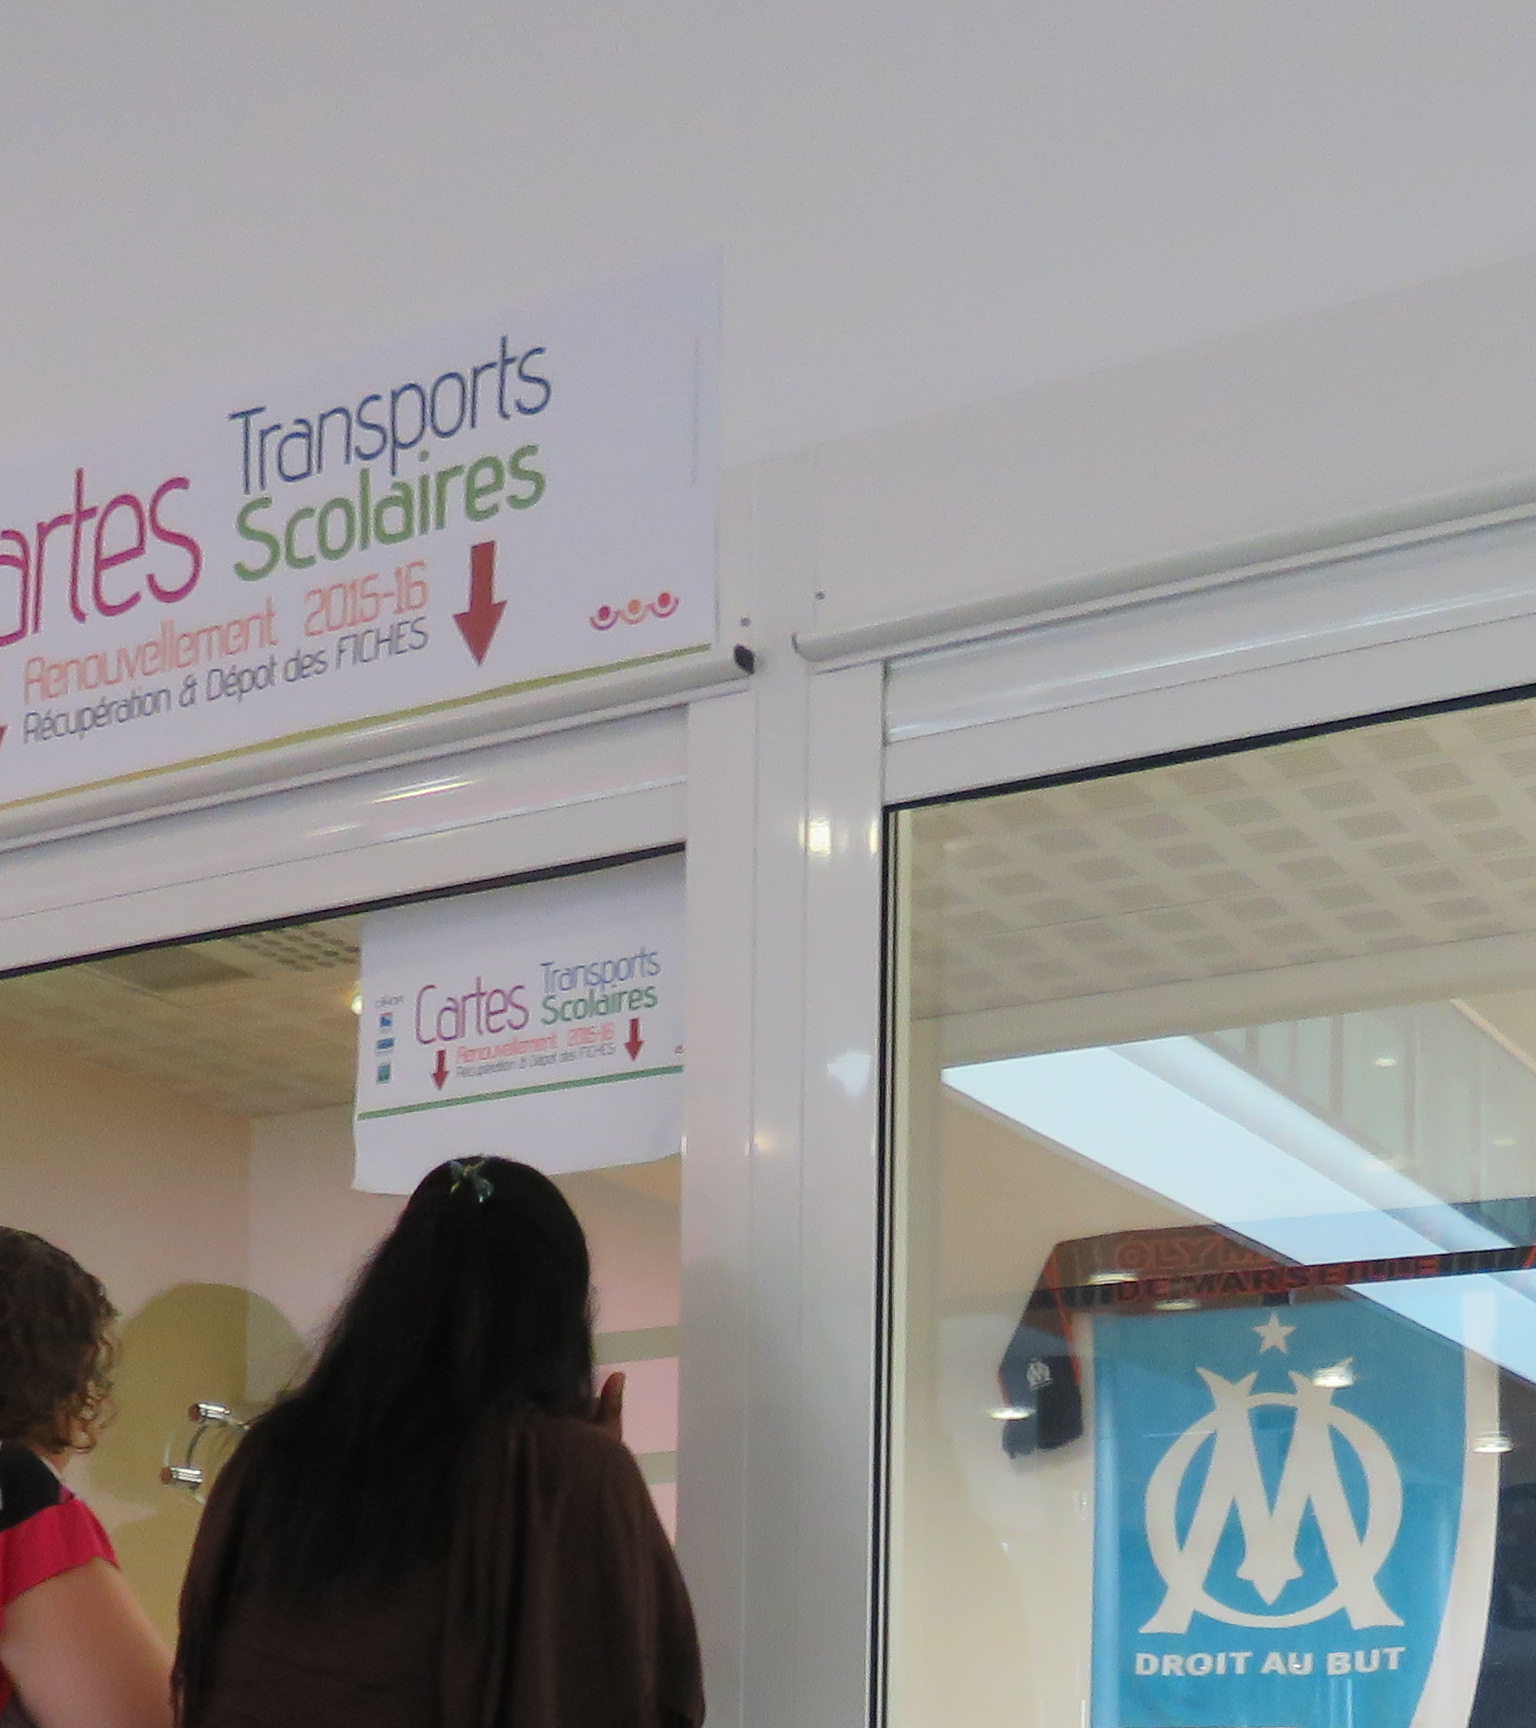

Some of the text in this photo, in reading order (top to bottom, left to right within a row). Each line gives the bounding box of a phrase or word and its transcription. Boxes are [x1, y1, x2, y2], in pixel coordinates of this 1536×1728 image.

[229, 335, 553, 493] Transports
[233, 443, 547, 582] Scolaires
[23, 684, 172, 744] Récupération
[178, 675, 197, 708] &
[283, 648, 328, 682] des
[335, 615, 429, 671] FICHES
[24, 597, 279, 704] Renouvellement
[415, 976, 530, 1045] Cartes
[539, 947, 662, 995] Transports
[540, 985, 658, 1026] Scolaires
[1135, 1646, 1406, 1677] DROIT AU BUT
